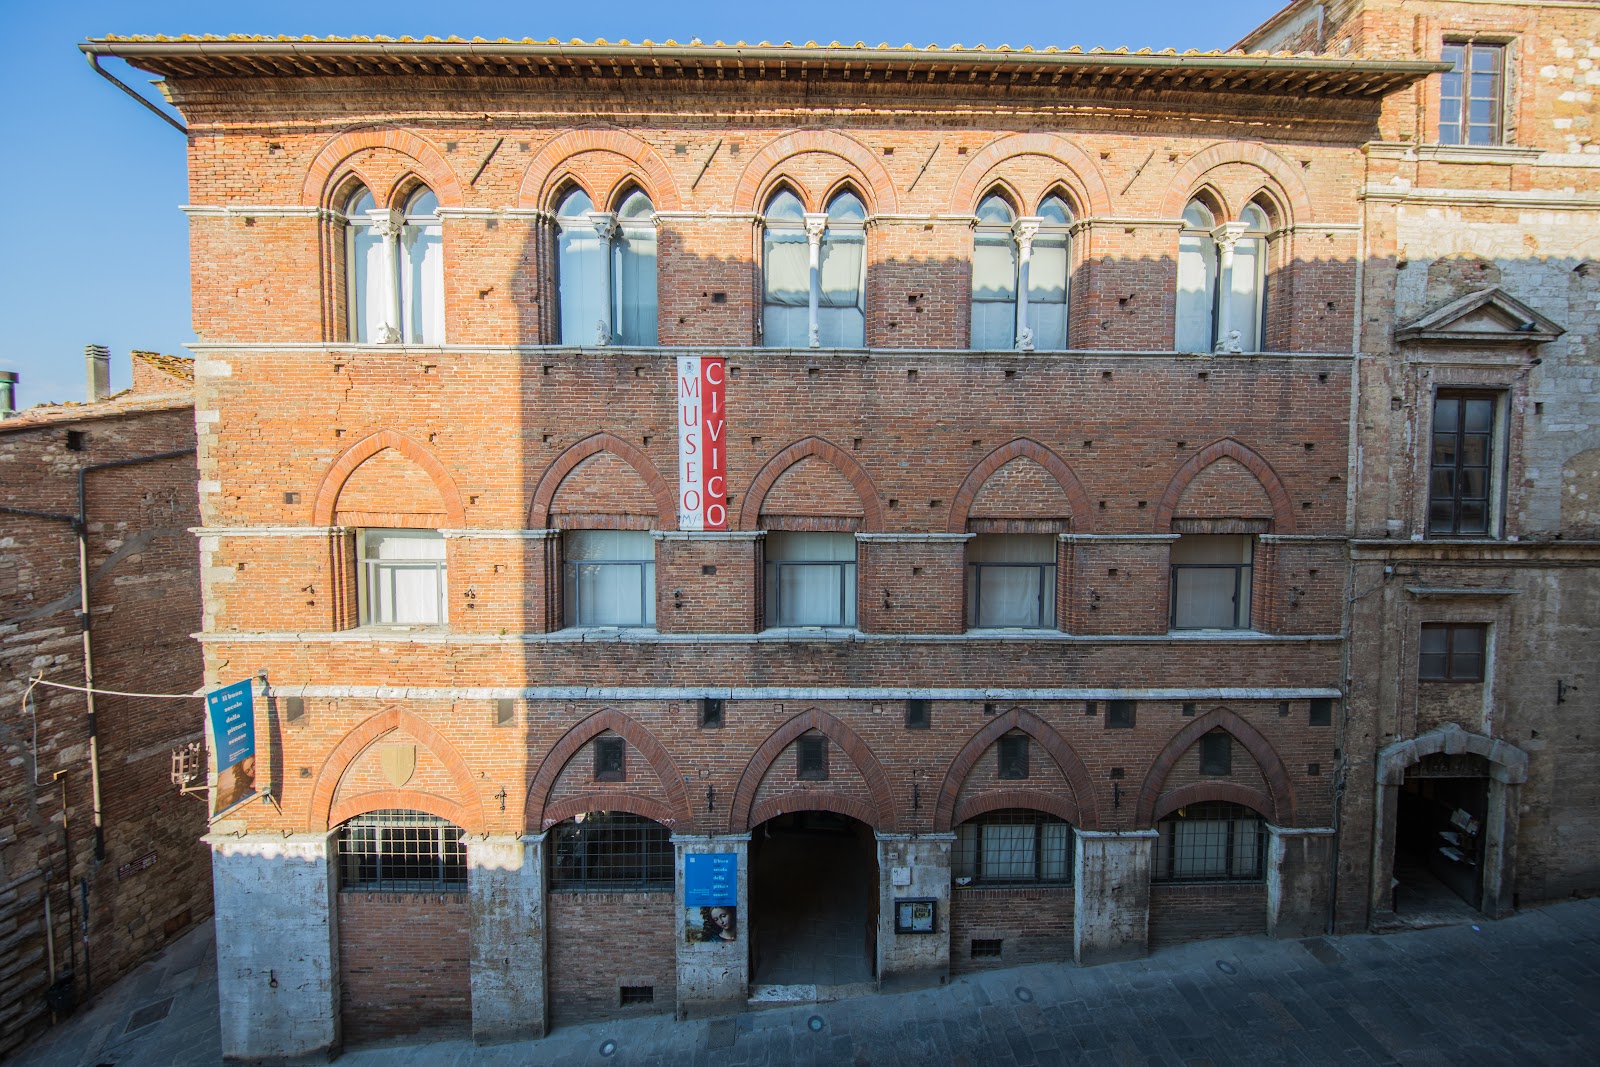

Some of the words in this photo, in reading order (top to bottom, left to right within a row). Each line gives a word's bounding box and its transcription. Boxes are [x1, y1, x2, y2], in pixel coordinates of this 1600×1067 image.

[681, 376, 701, 511] MUSEO
[705, 362, 726, 526] CIVICO
[228, 690, 243, 699] buon
[224, 701, 243, 712] secolo
[226, 713, 240, 723] della
[227, 722, 247, 735] pittura
[228, 733, 247, 745] senese
